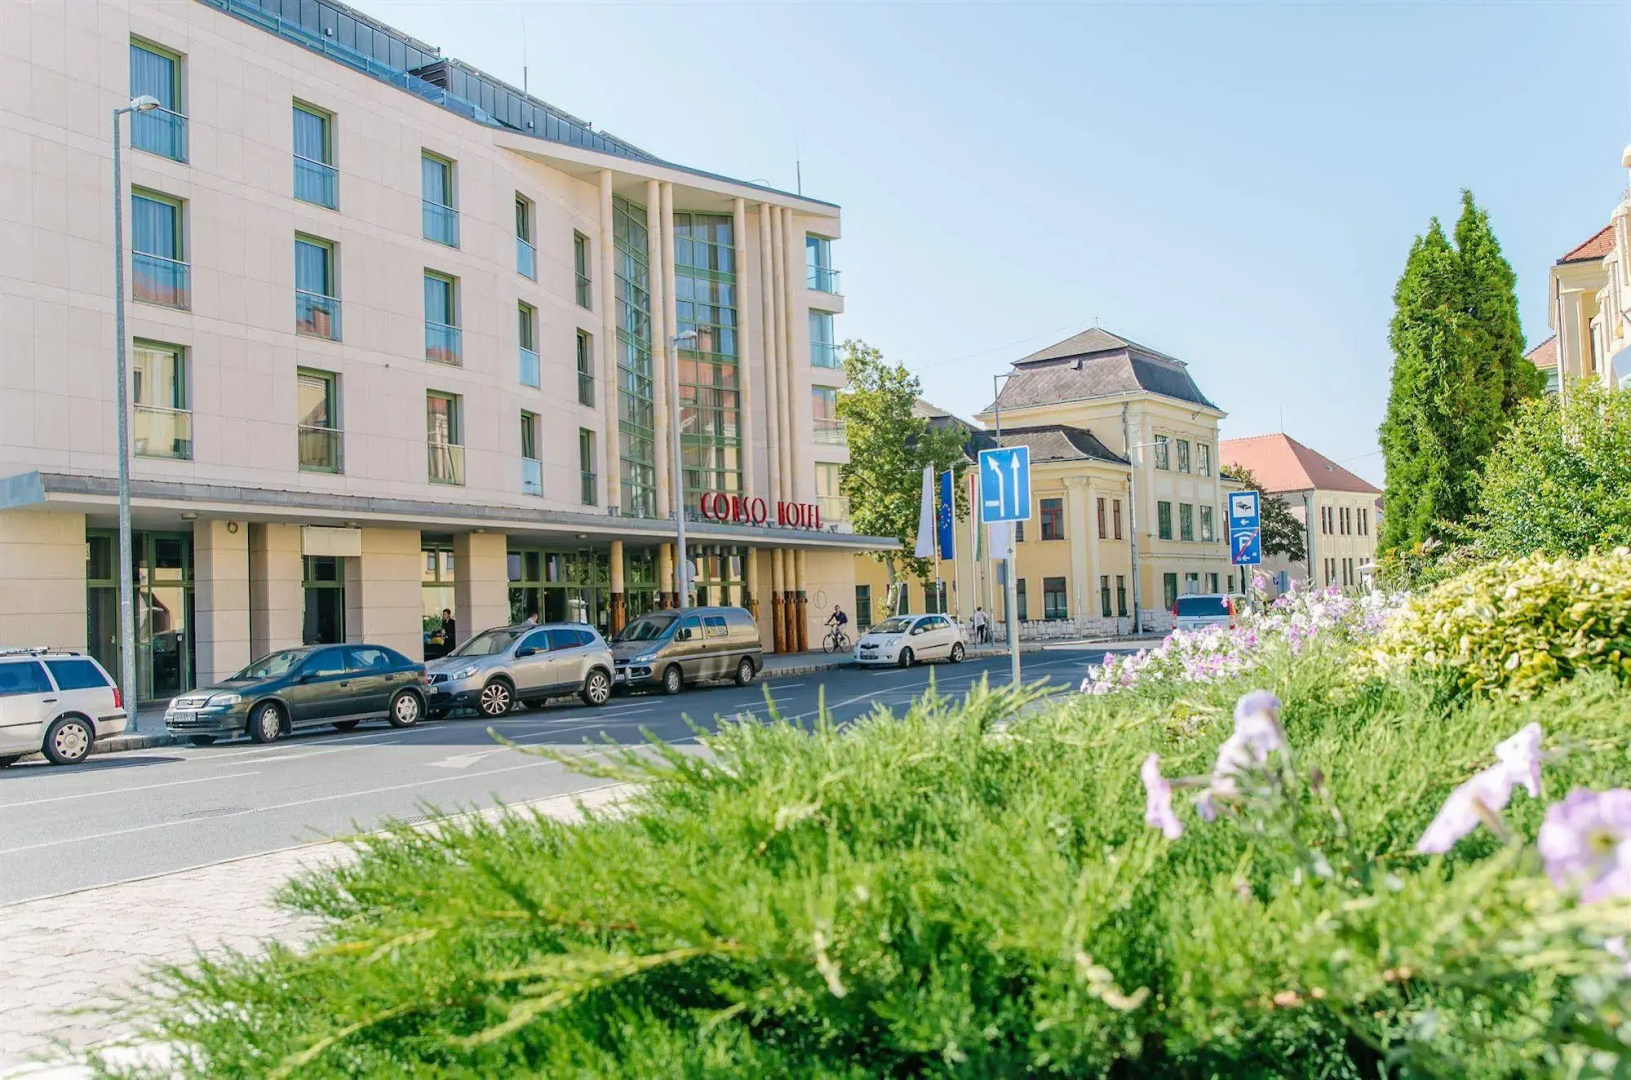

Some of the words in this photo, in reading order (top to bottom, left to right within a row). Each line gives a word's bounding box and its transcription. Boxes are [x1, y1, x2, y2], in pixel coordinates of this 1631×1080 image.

[701, 492, 767, 524] CORSO
[777, 501, 823, 529] HOTEL
[1239, 536, 1252, 554] P
